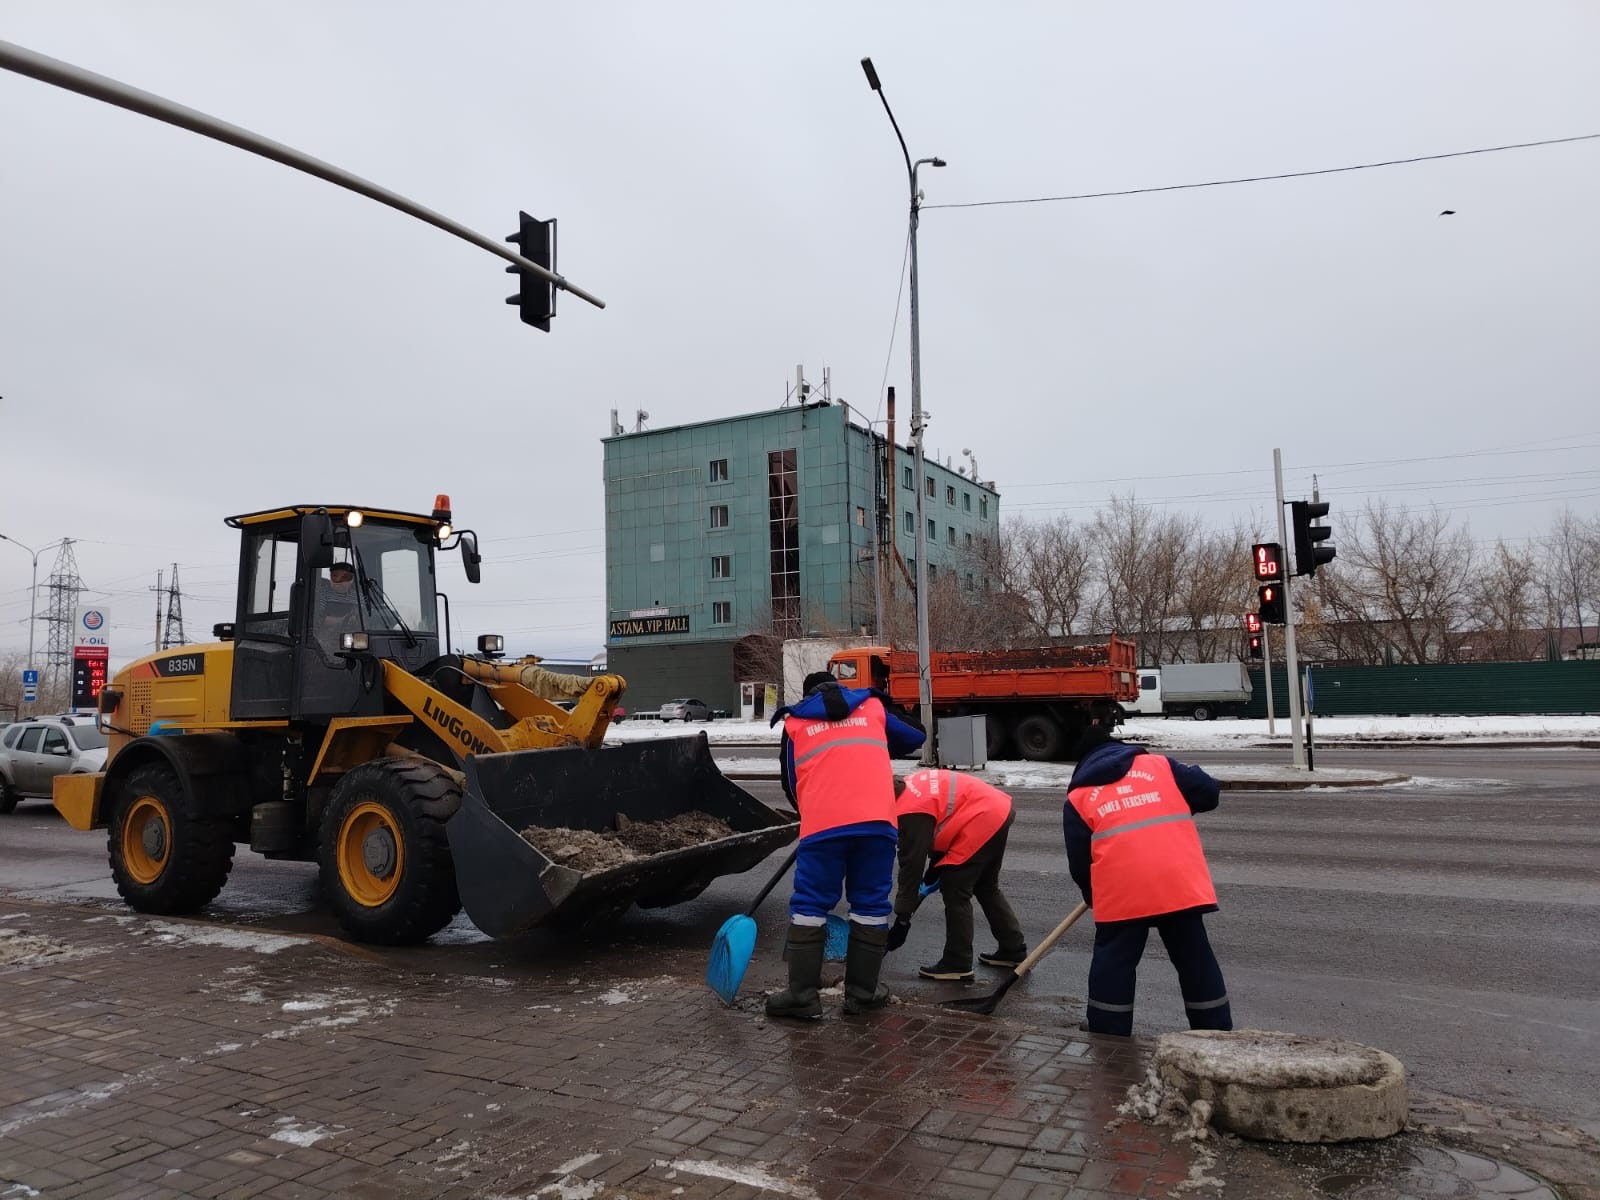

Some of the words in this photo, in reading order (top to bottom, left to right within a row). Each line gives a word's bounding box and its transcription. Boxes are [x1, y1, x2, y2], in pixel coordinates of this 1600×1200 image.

[1259, 561, 1277, 575] 60
[610, 620, 644, 635] ASTANA
[647, 619, 662, 633] VIP
[664, 617, 688, 632] HALL
[168, 658, 196, 671] 835N
